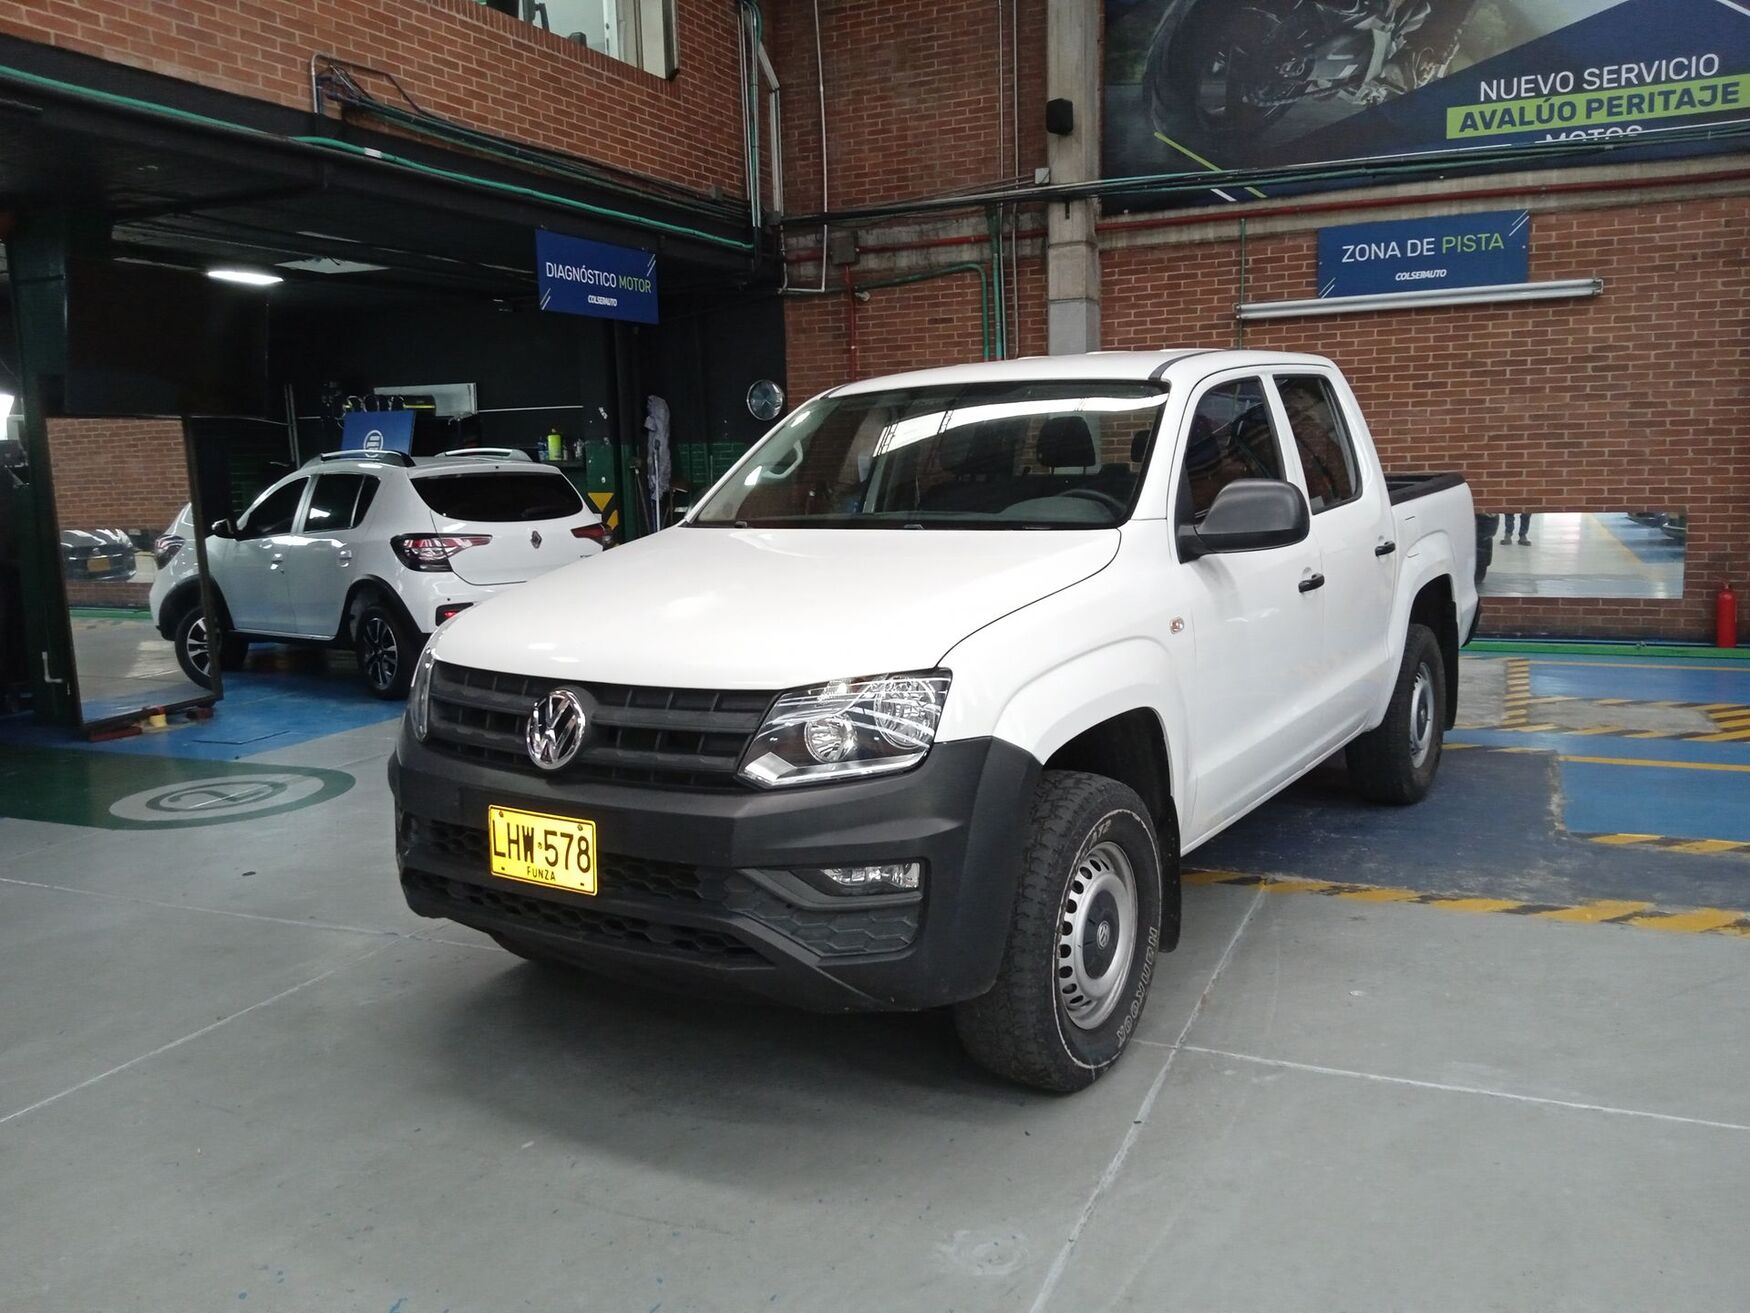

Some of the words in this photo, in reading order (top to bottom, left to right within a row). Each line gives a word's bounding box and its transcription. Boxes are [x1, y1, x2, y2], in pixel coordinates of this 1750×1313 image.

[1480, 71, 1574, 102] NUEVO
[1582, 53, 1720, 90] SERVICIO
[1458, 97, 1577, 133] AVALÚO
[1586, 81, 1740, 120] PERITAJE
[1341, 241, 1401, 263] ZONA
[1407, 238, 1435, 257] DE
[1442, 233, 1504, 254] PISTA
[545, 262, 617, 288] DIAGNÓSTICO
[618, 275, 652, 293] MOTOR
[492, 820, 534, 864] LHW
[544, 829, 591, 873] 578
[527, 866, 556, 881] FUNZA
